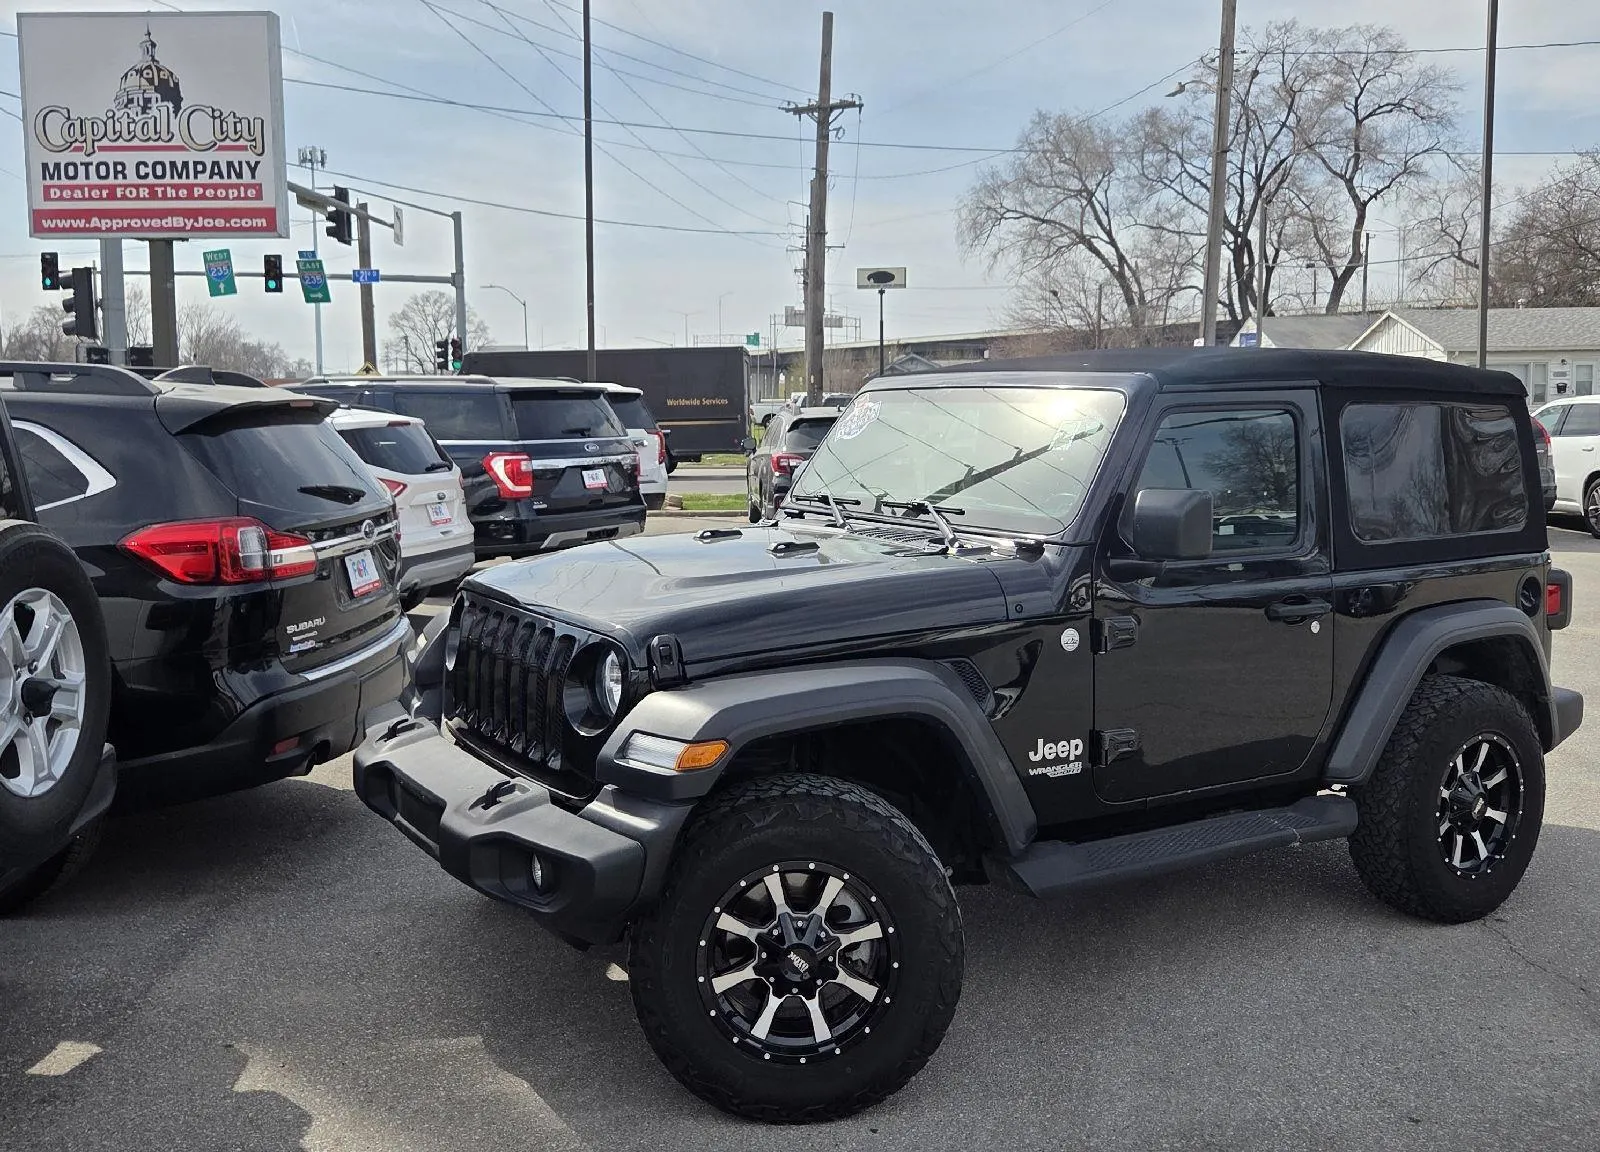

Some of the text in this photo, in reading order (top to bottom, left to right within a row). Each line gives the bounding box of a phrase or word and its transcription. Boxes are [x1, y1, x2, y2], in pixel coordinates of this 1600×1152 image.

[34, 104, 265, 157] Capital City
[41, 160, 261, 181] MOTOR COMPANY
[50, 186, 257, 200] Dealer FOR The People
[41, 216, 267, 231] www.ApprovedByJoe.com
[210, 265, 229, 277] 235
[304, 274, 323, 285] 235
[666, 397, 729, 407] Worldwide Services
[286, 616, 326, 634] SUBARU
[1028, 738, 1084, 762] Jeep
[1028, 762, 1083, 776] WRANGLER
